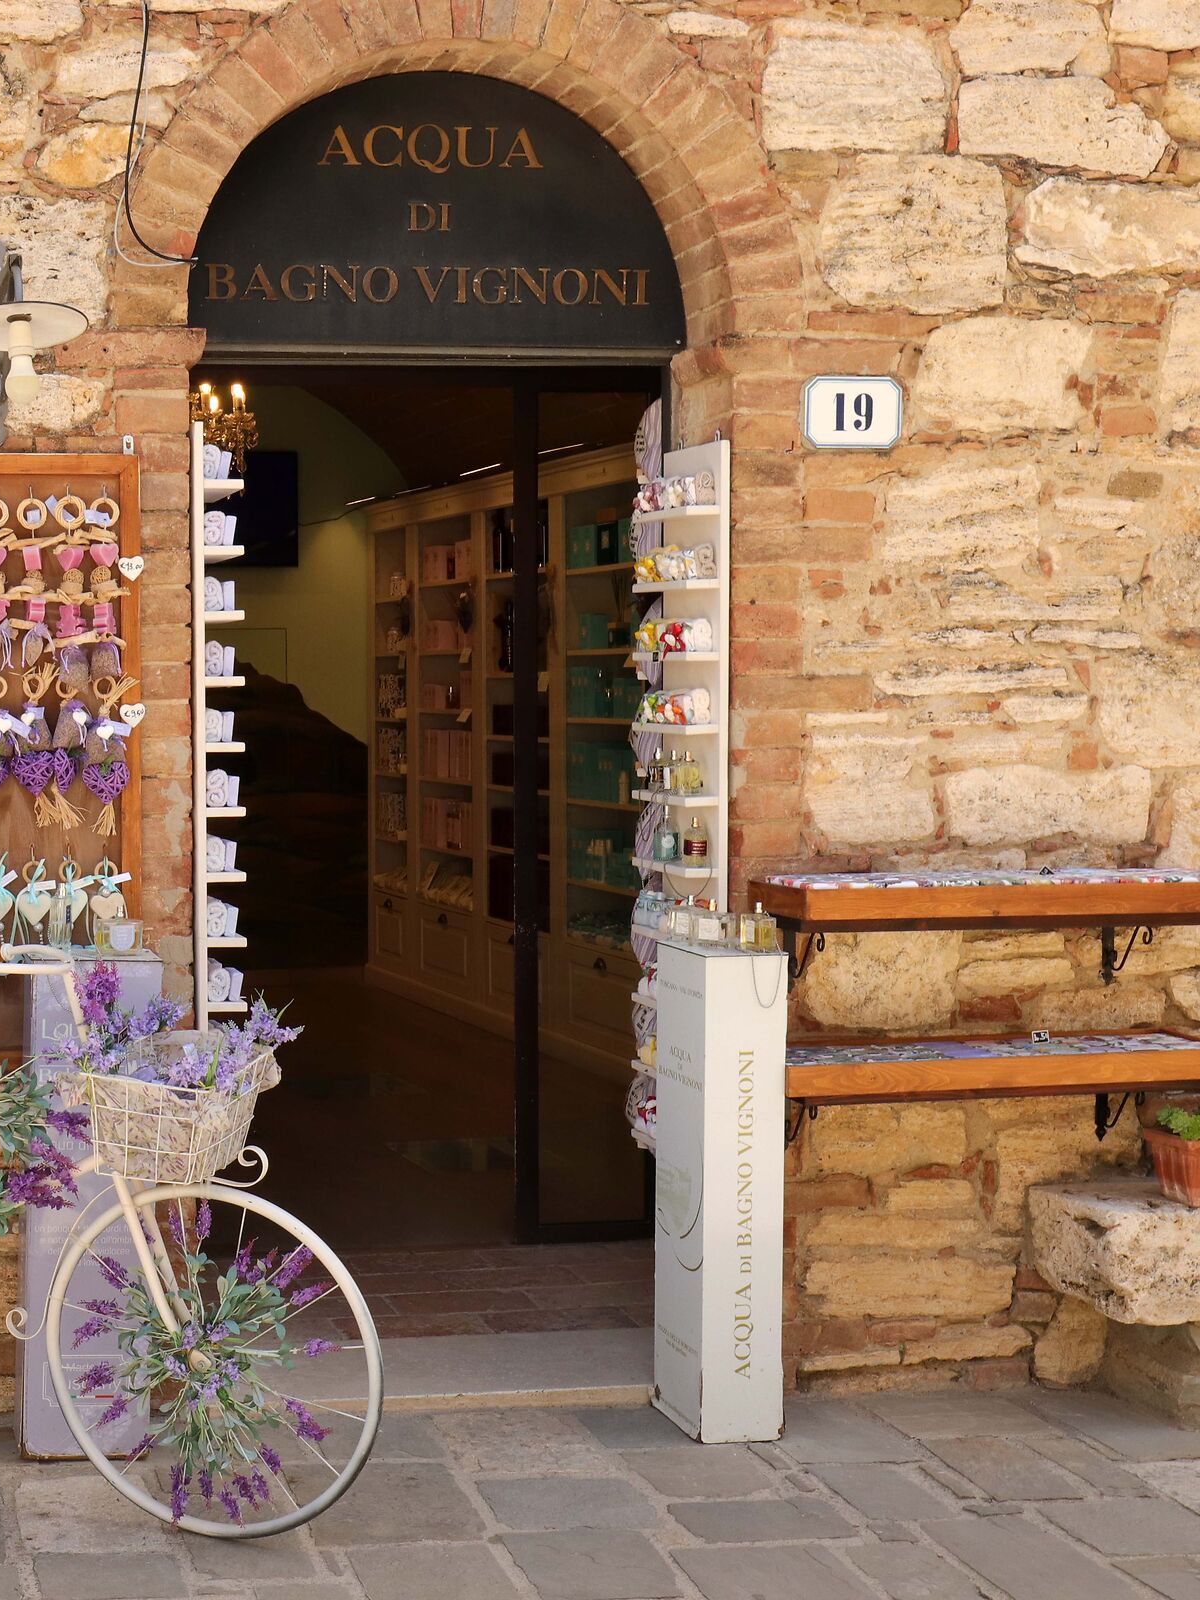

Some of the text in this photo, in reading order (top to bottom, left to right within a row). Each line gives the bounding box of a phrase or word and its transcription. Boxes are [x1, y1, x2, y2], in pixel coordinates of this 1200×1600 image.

[316, 124, 544, 174] ACQUA
[407, 202, 451, 232] DI
[204, 262, 650, 306] BAGNO VIGNONI
[832, 392, 874, 432] 19
[669, 1045, 692, 1063] ACQUA
[733, 1050, 754, 1380] ACQUA DI BAGNO VIGNONI
